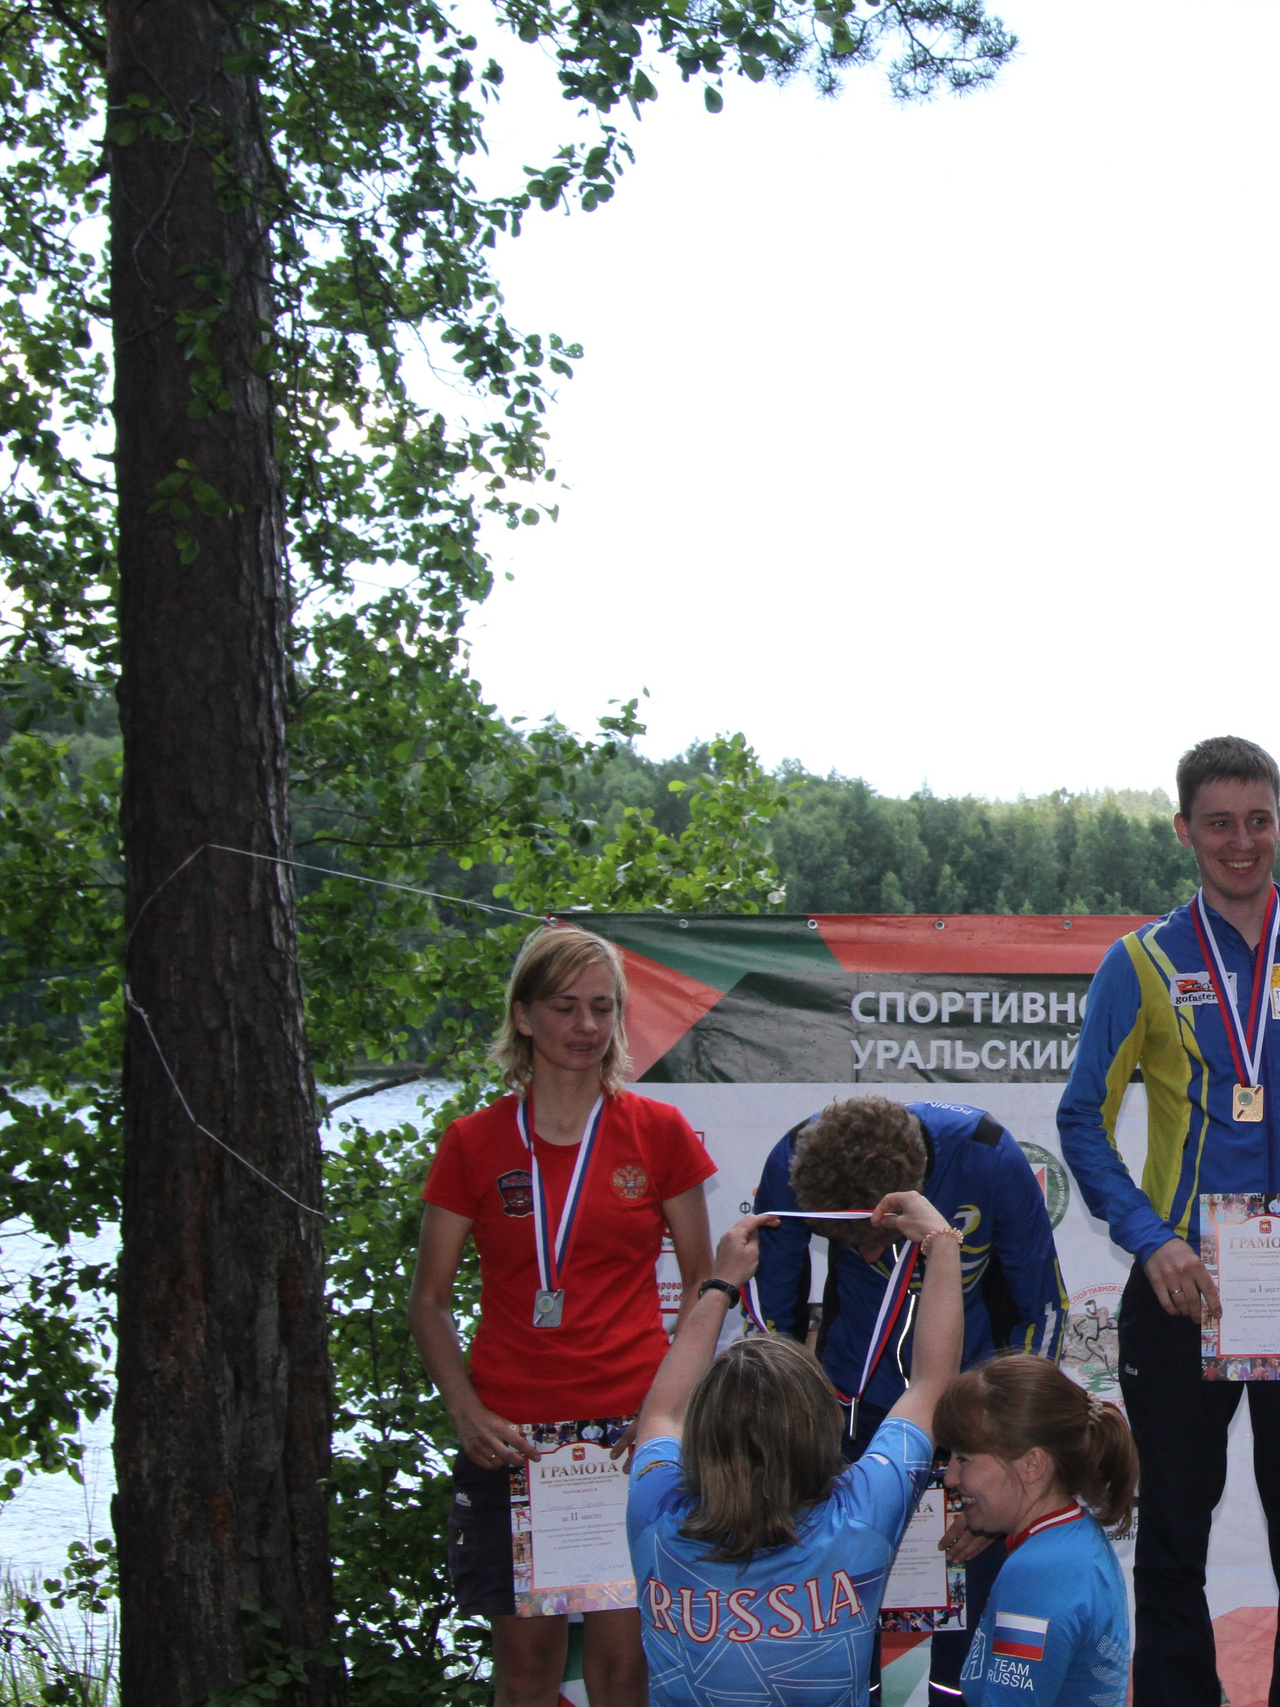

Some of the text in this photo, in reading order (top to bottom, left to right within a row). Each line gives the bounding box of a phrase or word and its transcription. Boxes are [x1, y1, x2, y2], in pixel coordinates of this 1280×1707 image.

[851, 991, 1088, 1024] СПОРТИВН
[540, 1461, 619, 1479] ГРАМОТА
[571, 1512, 578, 1521] II
[648, 1569, 863, 1644] RUSSIA
[994, 1658, 1030, 1677] TEAM
[986, 1669, 1034, 1691] RUSSIA
